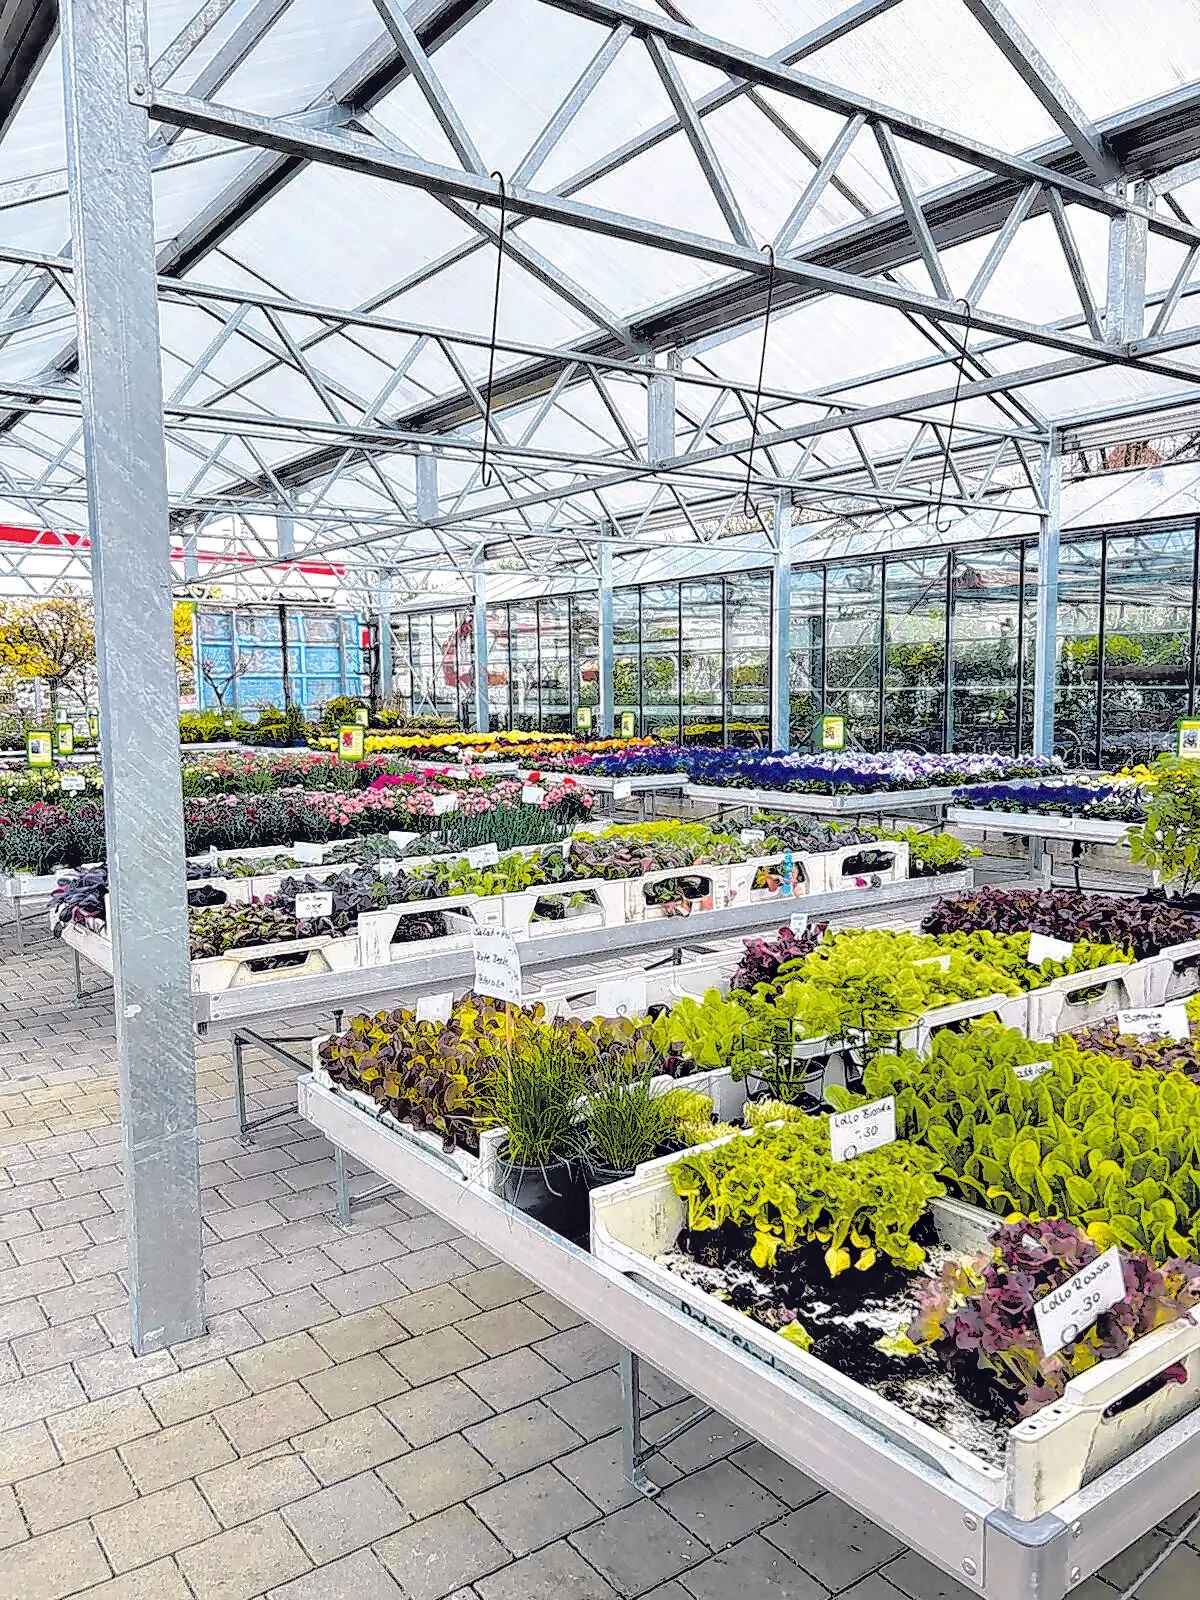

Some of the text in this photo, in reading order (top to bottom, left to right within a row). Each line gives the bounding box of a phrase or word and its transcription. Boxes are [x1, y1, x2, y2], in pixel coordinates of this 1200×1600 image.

[834, 1113, 860, 1128] Lollo
[1040, 1261, 1111, 1315] Lollo Rossa
